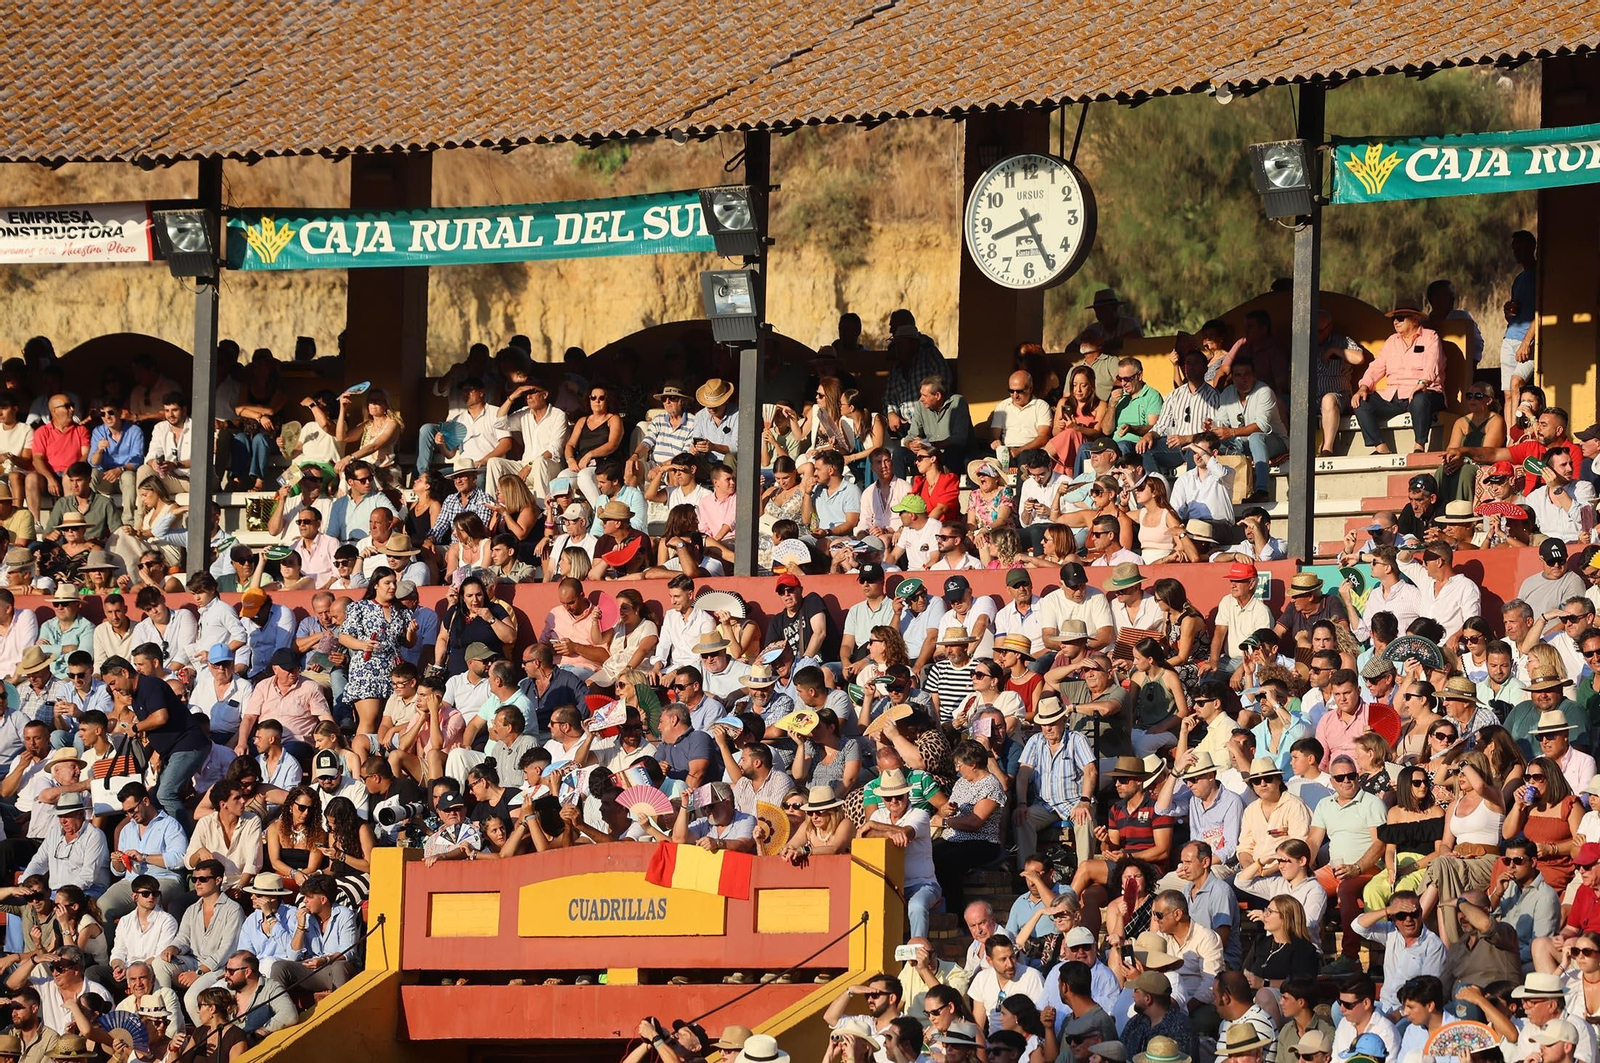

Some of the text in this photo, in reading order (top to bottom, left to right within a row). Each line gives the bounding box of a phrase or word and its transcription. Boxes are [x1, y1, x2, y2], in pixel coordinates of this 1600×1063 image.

[1021, 163, 1039, 180] 12
[1405, 148, 1511, 182] CAJA
[1004, 171, 1015, 189] 11
[1049, 168, 1056, 184] 1
[986, 192, 1004, 209] 10
[1016, 190, 1045, 200] URSUS
[1062, 186, 1072, 202] 2
[8, 210, 95, 224] EMPRESA
[981, 217, 993, 233] 9
[1067, 209, 1079, 226] 3
[299, 220, 396, 257] CAJA
[408, 215, 544, 252] RURAL
[553, 210, 635, 245] DEL
[106, 240, 137, 256] Plaza
[986, 243, 998, 259] 8
[1059, 236, 1071, 253] 4
[1002, 256, 1013, 273] 7
[1023, 262, 1035, 278] 6
[900, 582, 915, 594] VOX
[568, 898, 667, 921] CUADRILLAS
